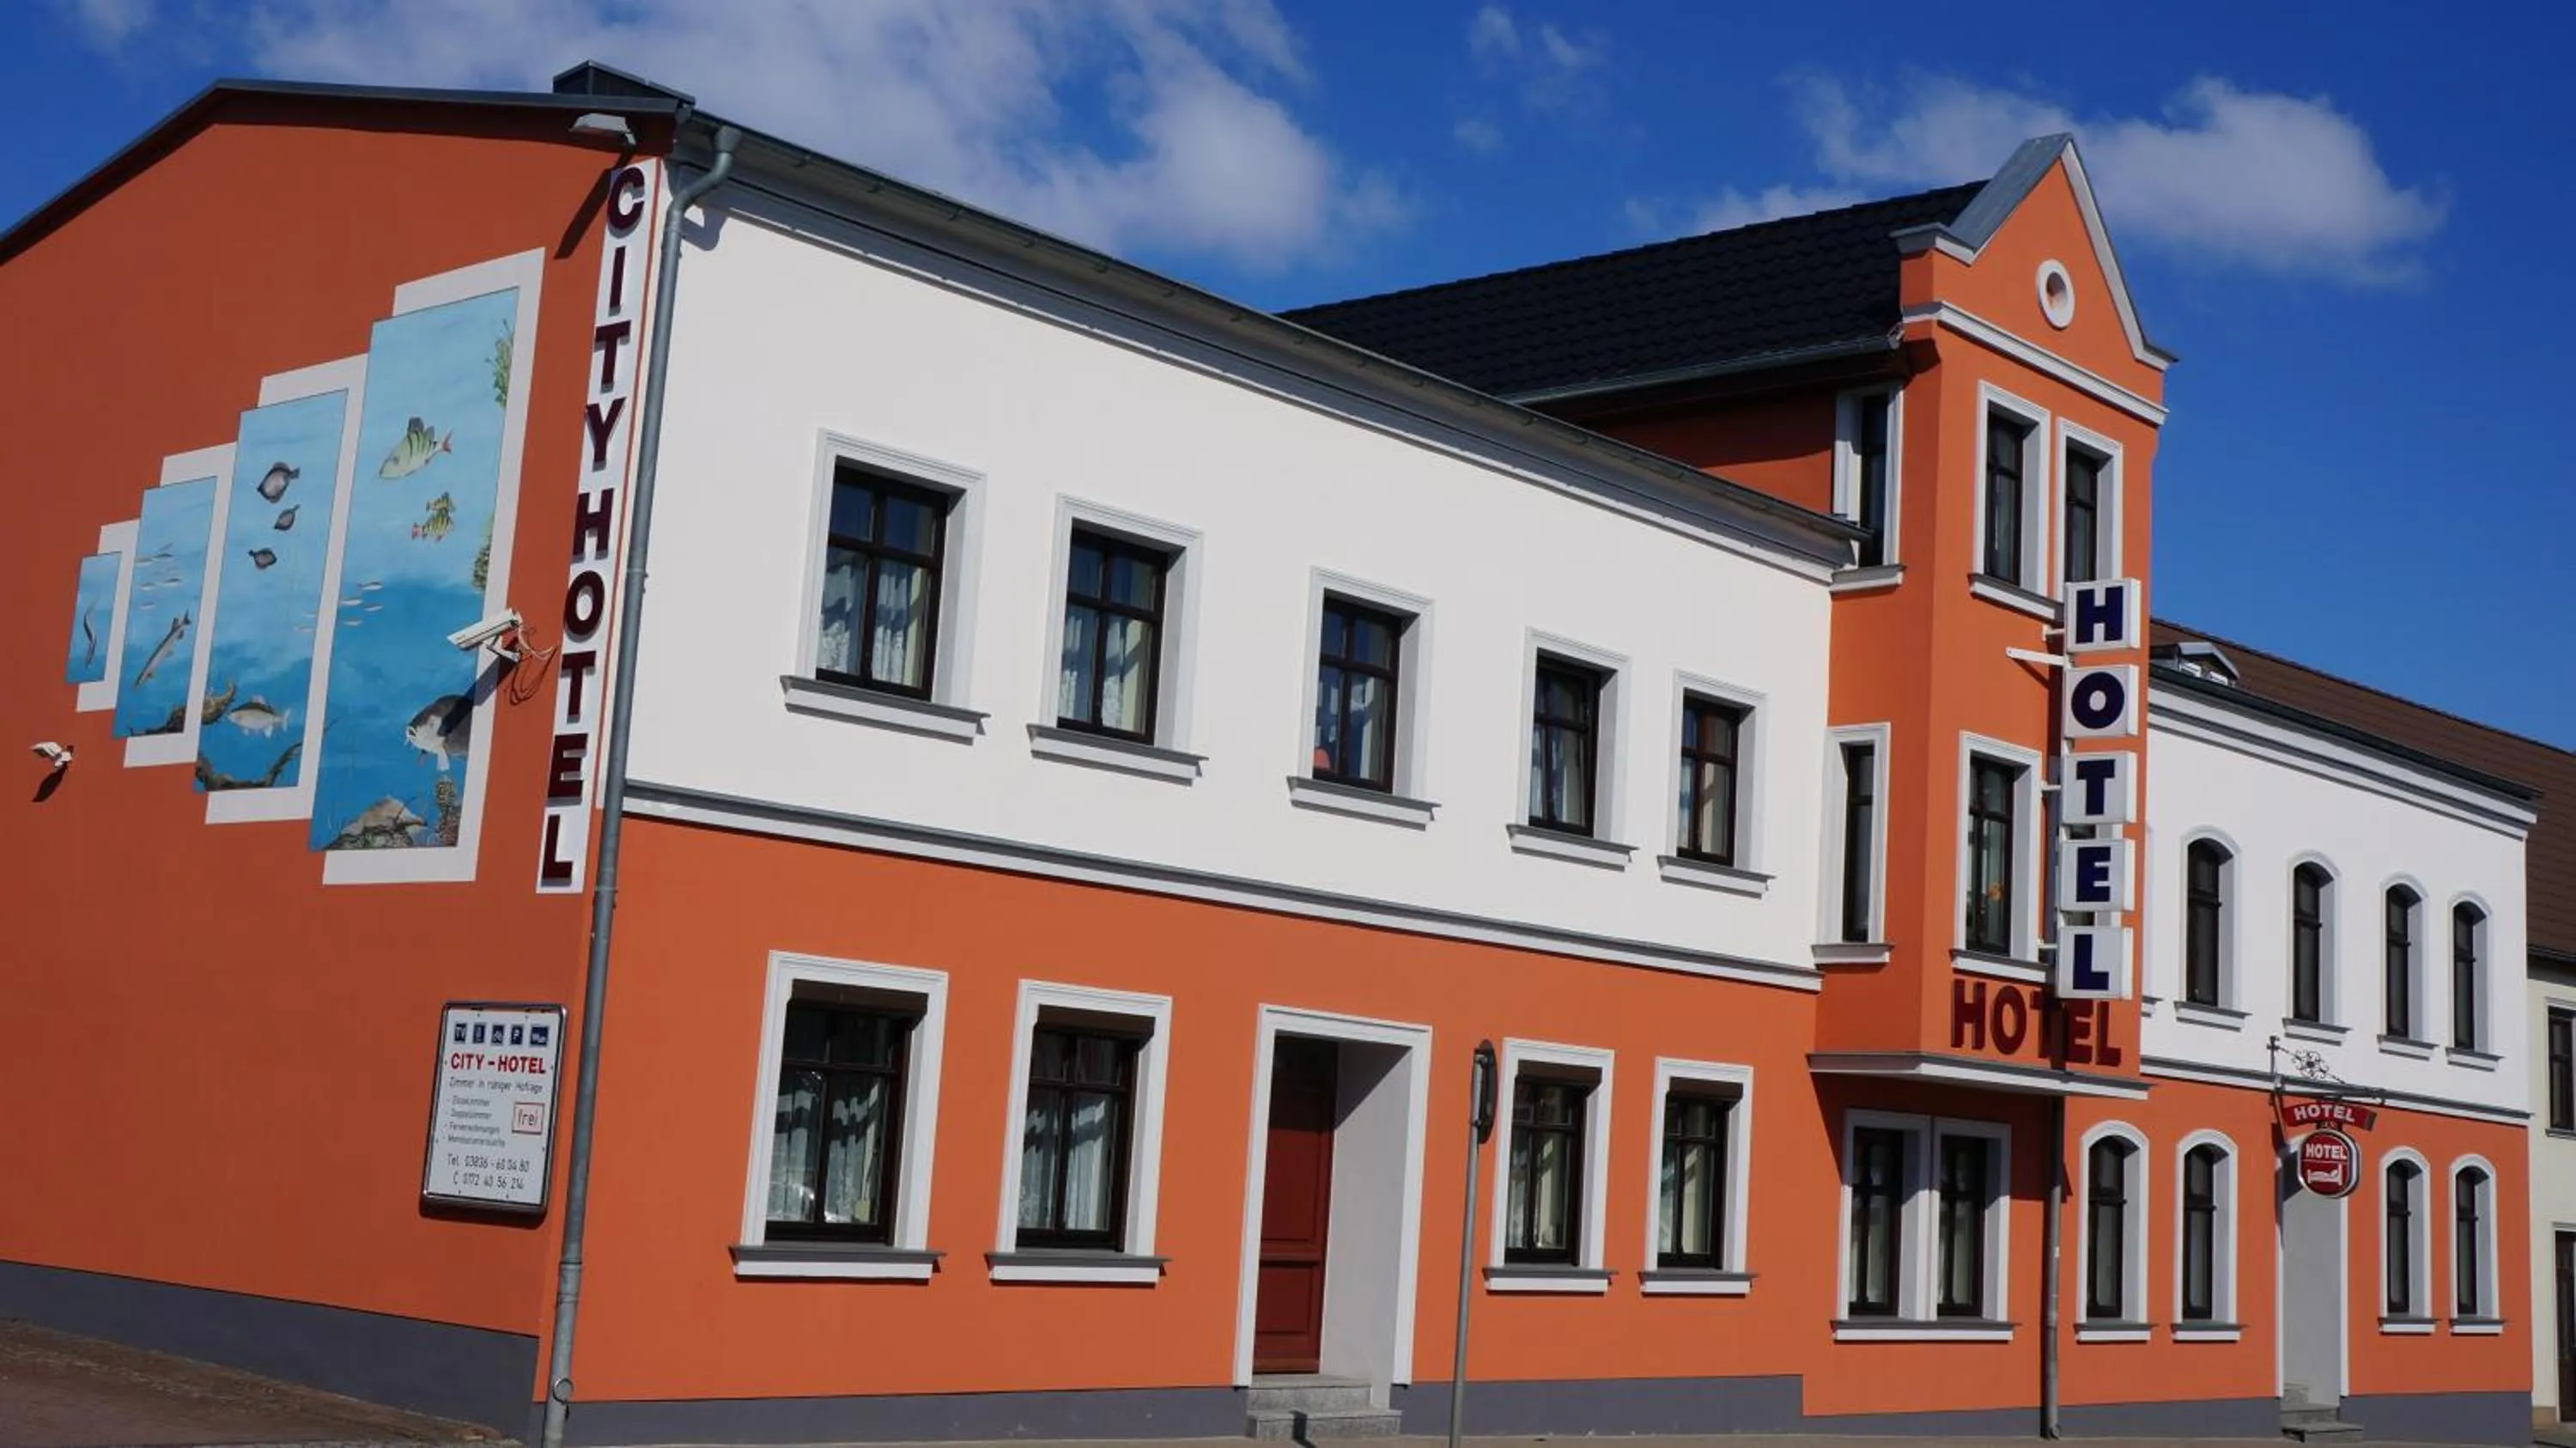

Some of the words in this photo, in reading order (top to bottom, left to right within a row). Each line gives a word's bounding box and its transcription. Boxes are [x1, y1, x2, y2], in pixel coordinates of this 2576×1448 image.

[2070, 585, 2125, 991] HOTEL
[1950, 978, 2122, 1067] HOTEL
[451, 1053, 485, 1070] CITY
[497, 1056, 547, 1074] HOTEL
[2293, 1104, 2356, 1123] HOTEL
[2306, 1143, 2347, 1159] HOTEL
